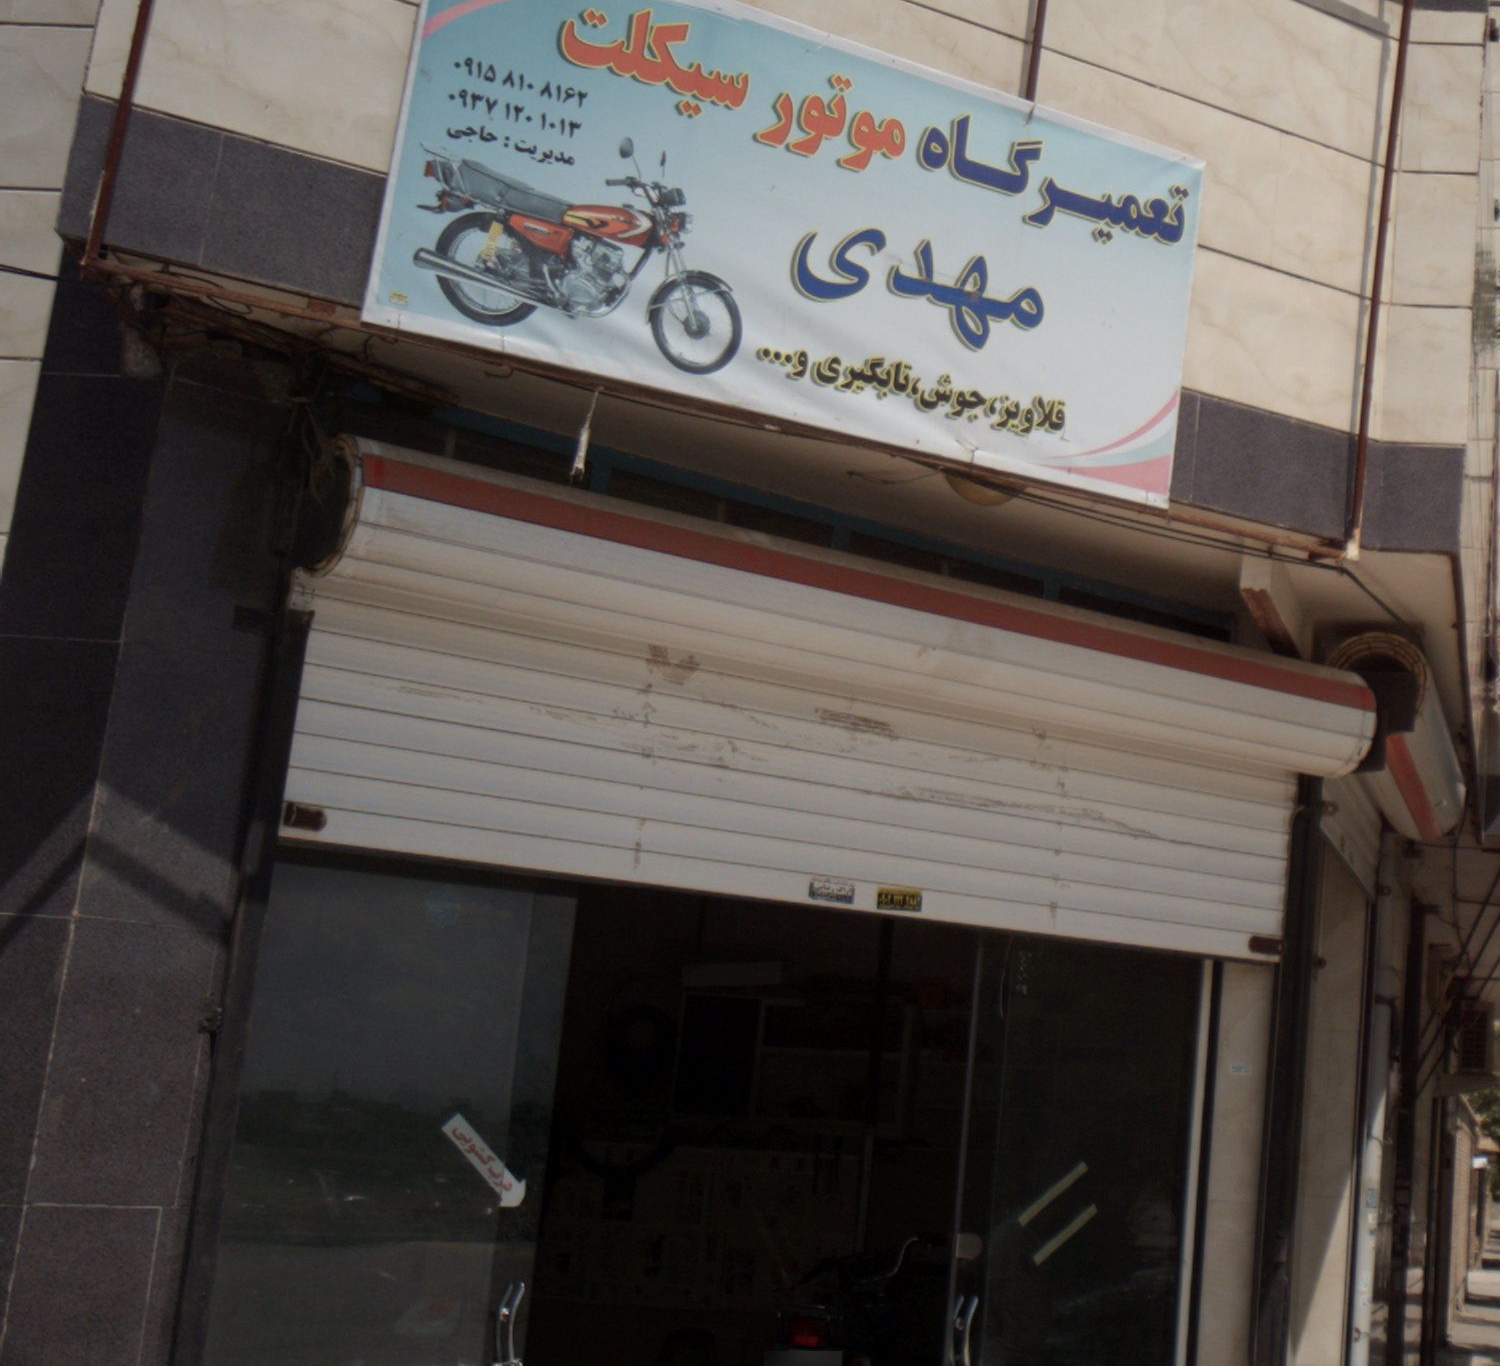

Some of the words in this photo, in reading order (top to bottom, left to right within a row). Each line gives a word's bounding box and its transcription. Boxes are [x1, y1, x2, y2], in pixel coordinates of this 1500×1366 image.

[454, 57, 496, 83] ۰۹۱۵
[502, 70, 534, 91] ۸۱۰
[540, 81, 588, 109] ۸۱۶۲
[557, 8, 749, 118] سیکلت
[447, 125, 498, 143] حاجی
[448, 89, 498, 115] ۰۹۳۷
[505, 102, 533, 123] ۱۲۰
[541, 112, 582, 139] ۱۰۱۳
[753, 73, 907, 172] موتور
[791, 228, 1045, 353] مهدی
